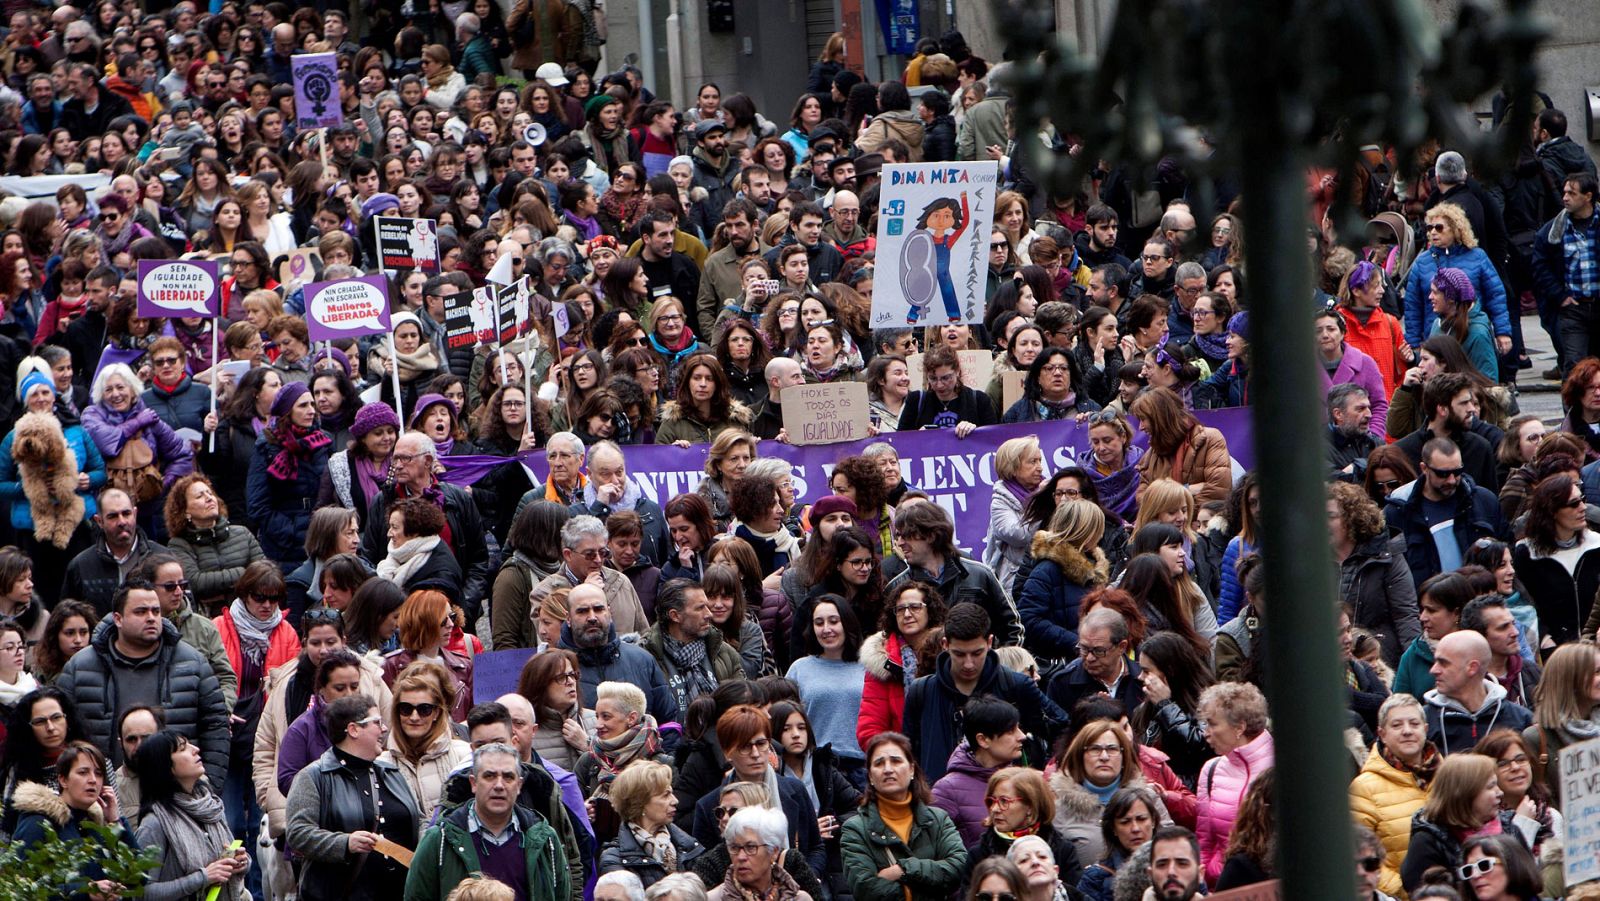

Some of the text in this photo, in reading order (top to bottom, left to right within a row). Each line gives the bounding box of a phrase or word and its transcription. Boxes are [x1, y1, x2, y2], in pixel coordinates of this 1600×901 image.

[170, 265, 187, 273] SEN
[154, 273, 204, 281] IGUALDADE
[150, 290, 205, 301] LIBERDADE
[325, 284, 365, 296] NIN CRIADAS
[336, 292, 369, 302] ESCRAVAS
[327, 301, 372, 313] Mulleres
[322, 308, 380, 323] LIBERADAS
[448, 327, 494, 348] FEMINISTA
[801, 387, 846, 398] HOXE E
[805, 398, 851, 411] TODOS OS
[803, 420, 854, 441] IGUALDADE
